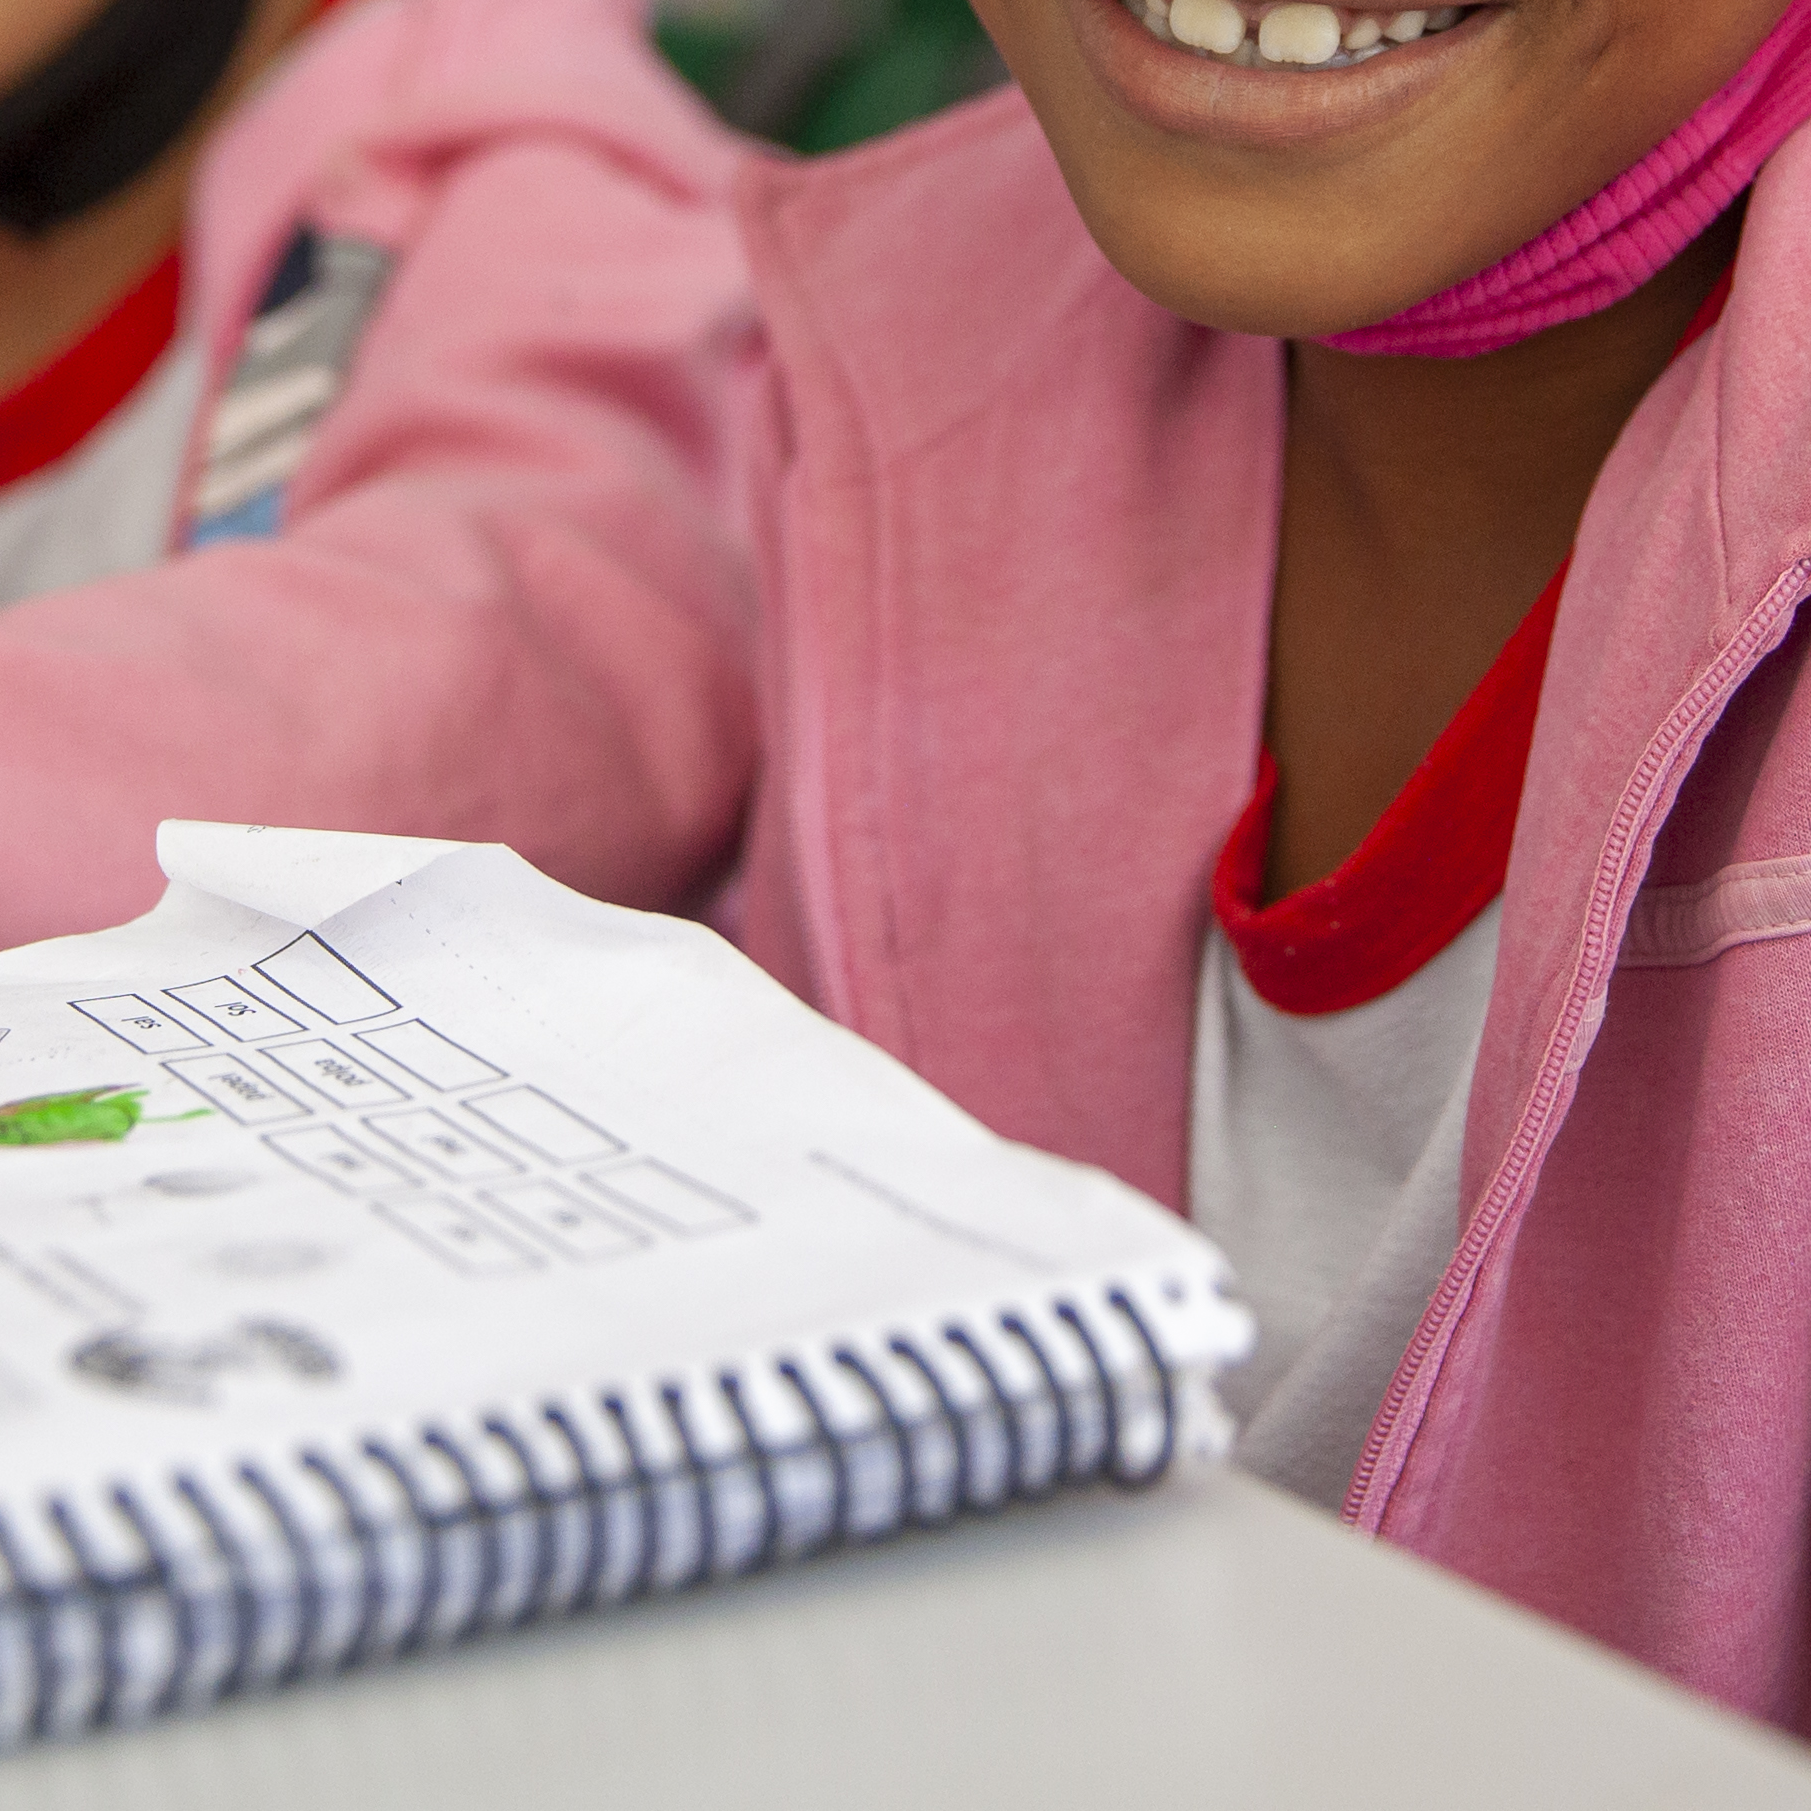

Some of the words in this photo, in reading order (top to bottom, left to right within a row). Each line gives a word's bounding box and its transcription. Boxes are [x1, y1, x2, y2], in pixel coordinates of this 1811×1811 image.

[120, 1015, 162, 1030] sal
[313, 1057, 372, 1087] polpa
[206, 1073, 274, 1101] papel
